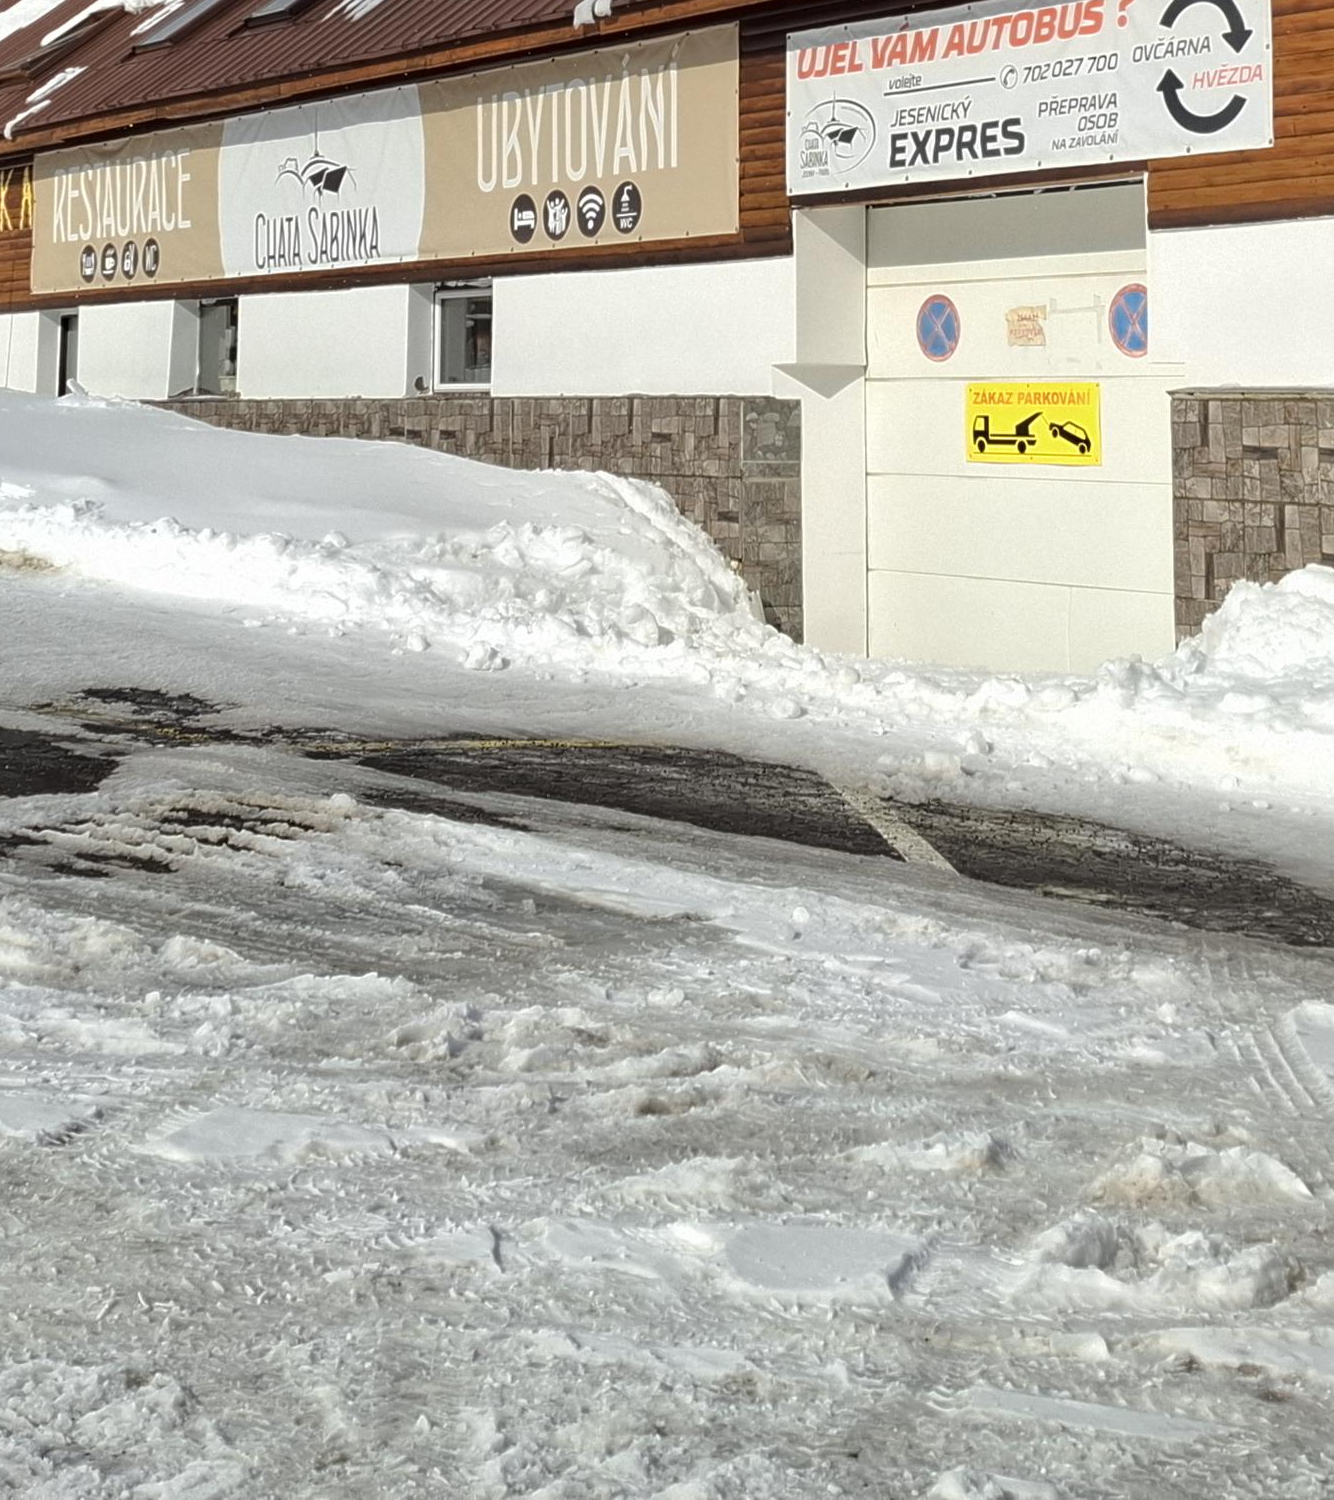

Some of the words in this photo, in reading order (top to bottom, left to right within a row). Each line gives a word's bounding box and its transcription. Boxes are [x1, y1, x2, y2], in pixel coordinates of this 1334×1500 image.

[797, 42, 864, 80] UJEL
[870, 22, 940, 69] VÁM
[1087, 52, 1119, 72] 700
[1132, 36, 1211, 63] OVČÁRNA
[888, 73, 922, 90] volejte
[1192, 63, 1264, 89] HVĚZDA
[477, 43, 680, 193] UBYTOVÁNÍ
[890, 95, 972, 128] JESENICKÝ
[1037, 92, 1118, 118] PŘEPRAVA
[1077, 112, 1119, 132] OSOB
[888, 117, 1025, 169] EXPRES
[1051, 138, 1066, 151] NA
[1068, 129, 1119, 149] ZAVOLÁNÍ
[53, 148, 191, 243] RESTAURACE
[620, 217, 633, 229] WC
[972, 388, 1013, 405] ZÁKAZ
[1017, 388, 1091, 405] PARKOVÁNÍ
